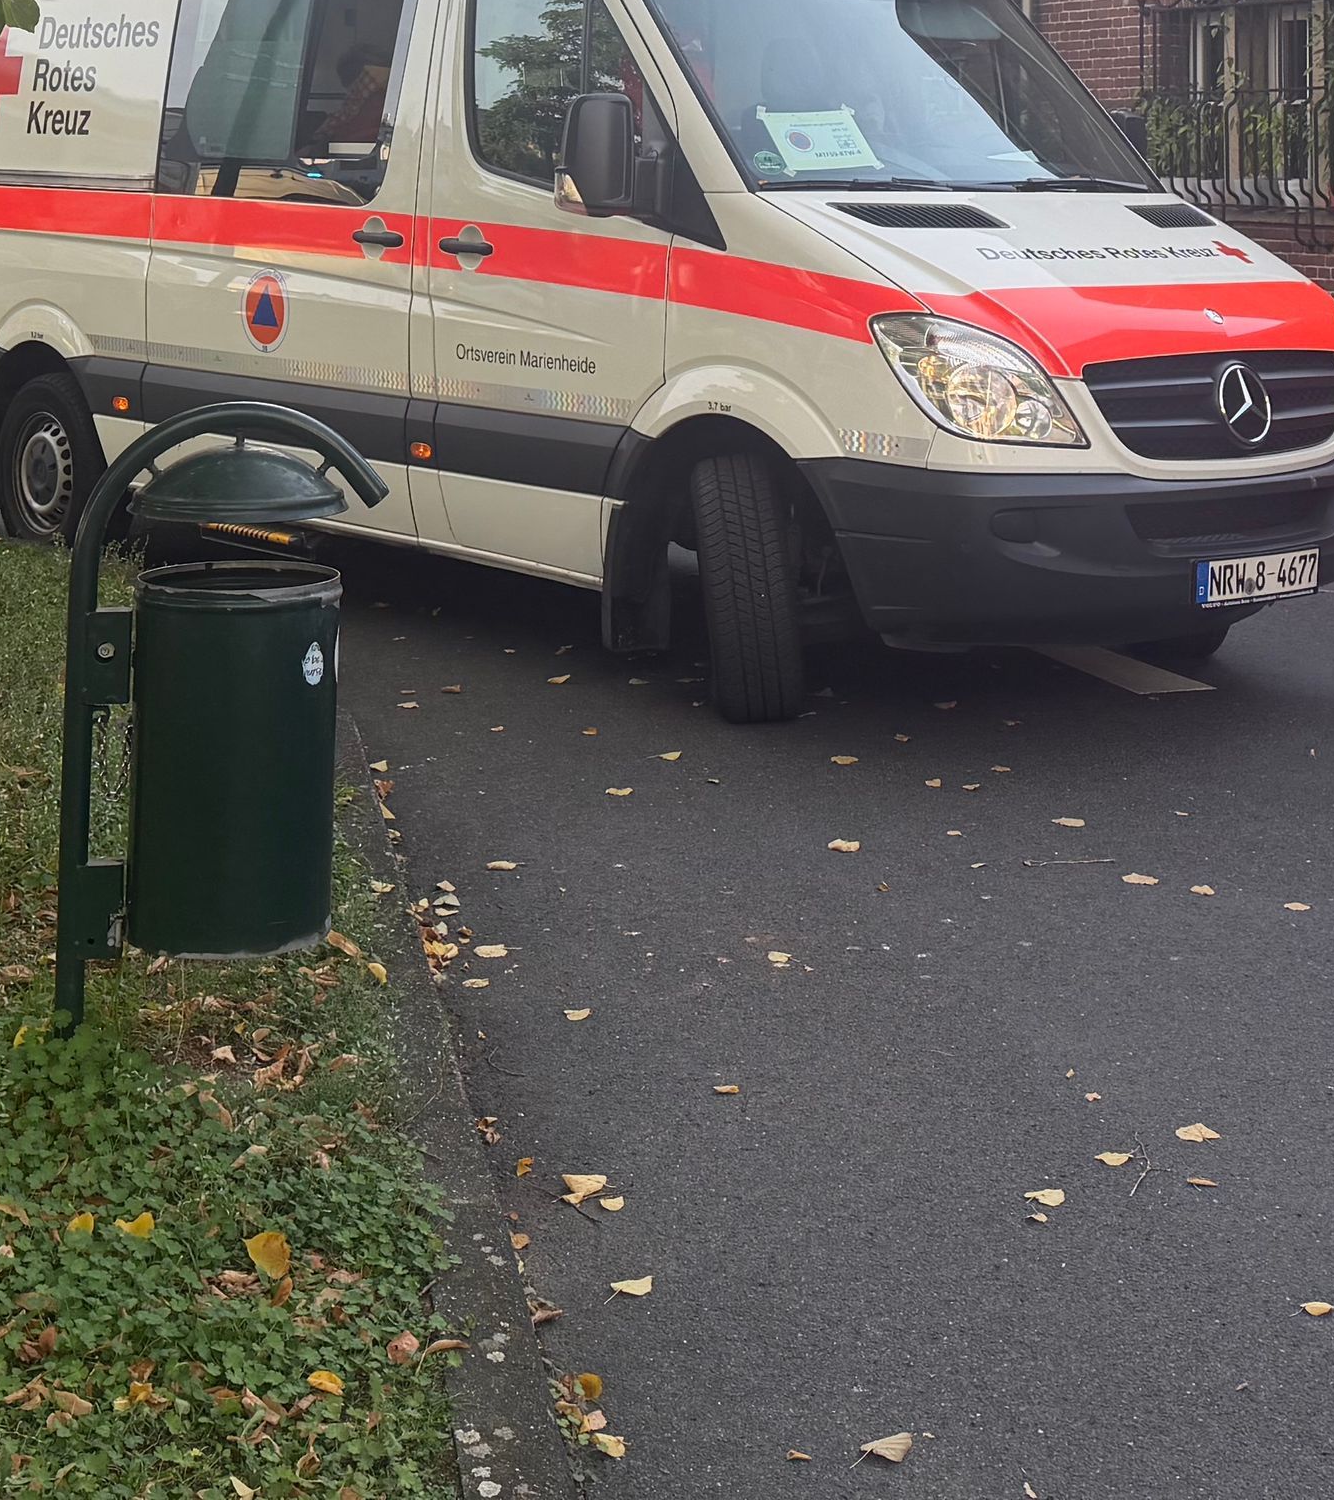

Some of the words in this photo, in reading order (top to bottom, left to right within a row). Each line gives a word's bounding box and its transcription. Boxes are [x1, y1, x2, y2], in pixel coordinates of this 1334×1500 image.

[38, 13, 161, 50] Deutsches
[32, 58, 97, 93] Rotes
[26, 100, 92, 136] Kreuz
[975, 247, 1108, 261] Deutsches
[1102, 247, 1169, 260] Rotes
[1162, 246, 1217, 259] Kreuz
[455, 343, 517, 366] Ortsverein
[519, 349, 597, 375] Marienheide
[720, 402, 732, 412] bar
[1199, 587, 1205, 595] D
[1209, 562, 1247, 597] NRW
[1255, 553, 1317, 591] 8-4677
